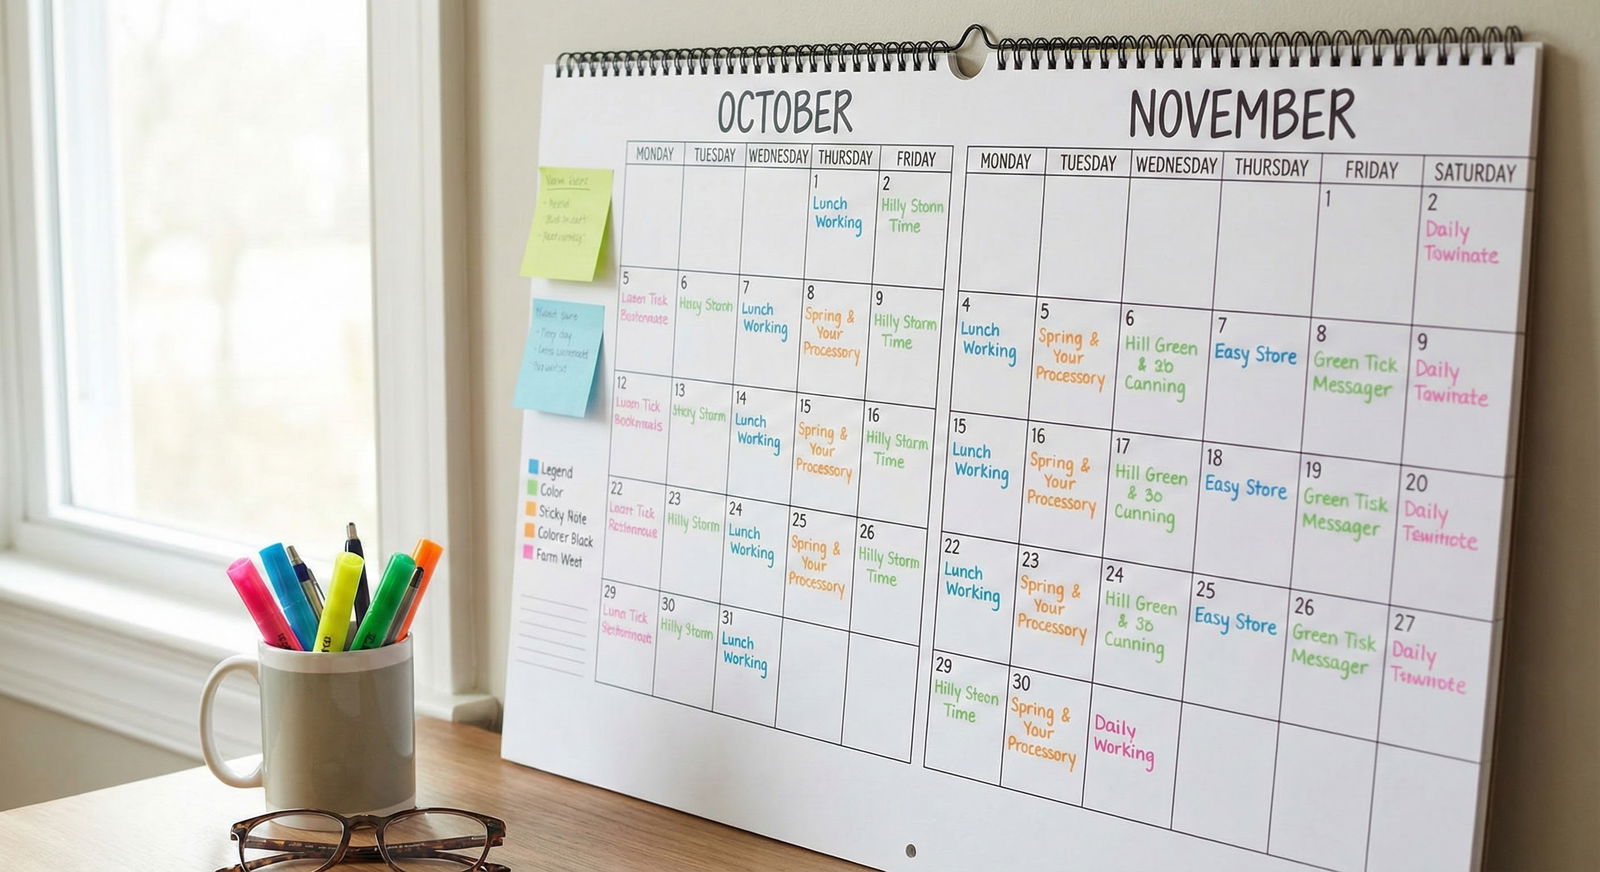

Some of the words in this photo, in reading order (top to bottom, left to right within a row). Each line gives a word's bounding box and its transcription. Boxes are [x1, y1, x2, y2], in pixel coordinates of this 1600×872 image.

[718, 88, 854, 135] OCTOBER
[1130, 88, 1356, 141] NOVEMBER
[637, 147, 674, 161] MONDAY
[694, 146, 736, 162] TUESDAY
[749, 149, 809, 164] WEDNESDAY
[818, 149, 874, 166] THURSDAY
[896, 150, 936, 167] FRIDAY
[980, 152, 1032, 170] MONDAY
[1060, 152, 1118, 172] TUESDAY
[1135, 154, 1219, 174] WEDNESDAY
[1235, 158, 1309, 177] THURSDAY
[1346, 160, 1399, 179] FRIDAY
[1435, 162, 1517, 183] SATURDAY
[814, 174, 819, 189] 1
[883, 176, 891, 192] 2
[813, 196, 847, 210] Lunch
[1326, 190, 1331, 207] 1
[1427, 193, 1438, 211] 2
[882, 198, 906, 219] Hilly
[816, 214, 862, 238] Working
[889, 217, 920, 233] Time
[1426, 220, 1470, 244] Daily
[623, 271, 629, 286] 5
[680, 275, 687, 289] 6
[743, 279, 749, 294] 7
[807, 285, 815, 301] 8
[875, 290, 884, 306] 9
[741, 302, 773, 315] Lunch
[961, 296, 970, 312] 4
[1040, 301, 1050, 319] 5
[805, 306, 841, 328] Spring
[847, 310, 854, 323] &
[875, 313, 900, 333] Hilly
[1126, 309, 1135, 327] 6
[1218, 317, 1227, 333] 7
[743, 319, 788, 343] Working
[743, 319, 788, 343] Working
[817, 326, 843, 340] Your
[960, 321, 999, 337] Lunch
[1316, 324, 1326, 342] 8
[882, 334, 912, 349] Time
[1039, 328, 1082, 351] Spring
[1090, 332, 1099, 346] &
[1126, 335, 1149, 351] Hill
[1155, 337, 1198, 355] Green
[1417, 333, 1428, 351] 9
[804, 341, 860, 366] Processory
[963, 340, 1016, 367] Working
[1053, 349, 1084, 364] Your
[1215, 343, 1250, 369] Easy
[1256, 345, 1297, 365] Store
[1314, 351, 1358, 369] Green
[1365, 354, 1397, 372] Tick
[1138, 357, 1146, 371] &
[1416, 359, 1459, 386] Daily
[617, 376, 626, 389] 12
[1036, 365, 1105, 392] Processory
[676, 383, 685, 397] 13
[736, 391, 746, 405] 14
[1313, 376, 1392, 404] Messager
[800, 398, 811, 413] 15
[735, 413, 767, 428] Lunch
[868, 407, 880, 423] 16
[799, 421, 834, 445] Spring
[840, 427, 848, 440] &
[953, 417, 967, 435] 15
[738, 431, 781, 456] Working
[867, 430, 891, 451] Hilly
[1032, 427, 1046, 444] 16
[810, 443, 835, 456] Your
[952, 441, 991, 459] Lunch
[1116, 436, 1130, 454] 17
[873, 452, 904, 468] Time
[1030, 451, 1074, 477] Spring
[1081, 457, 1090, 473] &
[1207, 448, 1223, 466] 18
[541, 462, 573, 481] Legend
[797, 457, 852, 484] Processory
[954, 462, 1010, 489] Working
[1116, 464, 1139, 480] Hill
[1146, 467, 1188, 486] Green
[1306, 461, 1321, 479] 19
[541, 483, 564, 498] Color
[611, 481, 623, 495] 22
[1044, 474, 1076, 490] Your
[1206, 474, 1239, 501] Easy
[1246, 479, 1287, 500] Store
[1406, 473, 1428, 492] 20
[668, 491, 681, 505] 23
[1128, 485, 1137, 499] &
[1304, 488, 1349, 507] Green
[729, 501, 742, 516] 24
[1027, 489, 1096, 519] Processory
[539, 505, 564, 526] Sticky
[668, 513, 689, 533] Hilly
[792, 511, 807, 528] 25
[1405, 500, 1448, 528] Daily
[729, 523, 760, 540] Lunch
[860, 523, 874, 540] 26
[1303, 513, 1380, 542] Messager
[571, 532, 593, 548] Black
[792, 535, 827, 560] Spring
[833, 541, 840, 555] &
[944, 538, 960, 555] 22
[802, 556, 827, 571] Your
[859, 546, 884, 569] Hilly
[1022, 550, 1040, 568] 23
[866, 569, 897, 587] Time
[944, 561, 983, 581] Lunch
[1105, 565, 1124, 583] 24
[604, 585, 616, 599] 29
[789, 571, 845, 600] Processory
[1021, 575, 1064, 603] Spring
[1072, 584, 1080, 598] &
[1196, 579, 1215, 599] 25
[662, 597, 676, 612] 30
[945, 581, 1001, 611] Working
[1106, 591, 1130, 608] Hill
[1136, 595, 1177, 616] Green
[1034, 599, 1065, 615] Your
[1294, 597, 1314, 616] 26
[722, 610, 733, 625] 31
[1118, 614, 1127, 628] &
[1195, 606, 1230, 635] Easy
[1236, 613, 1277, 635] Store
[1394, 613, 1415, 632] 27
[661, 618, 682, 640] Hilly
[1018, 612, 1087, 646] Processory
[1293, 623, 1338, 645] Green
[722, 631, 754, 650] Lunch
[723, 650, 768, 679] Working
[936, 656, 953, 673] 29
[1292, 648, 1369, 680] Messager
[1391, 640, 1436, 673] Daily
[935, 679, 961, 703] Hilly
[1012, 672, 1031, 692] 30
[943, 703, 976, 723] Time
[1011, 697, 1054, 726] Spring
[1061, 707, 1070, 722] &
[1024, 721, 1054, 739] Your
[1095, 714, 1136, 743] Daily
[1008, 735, 1076, 772] Processory
[1094, 736, 1154, 772] Working
